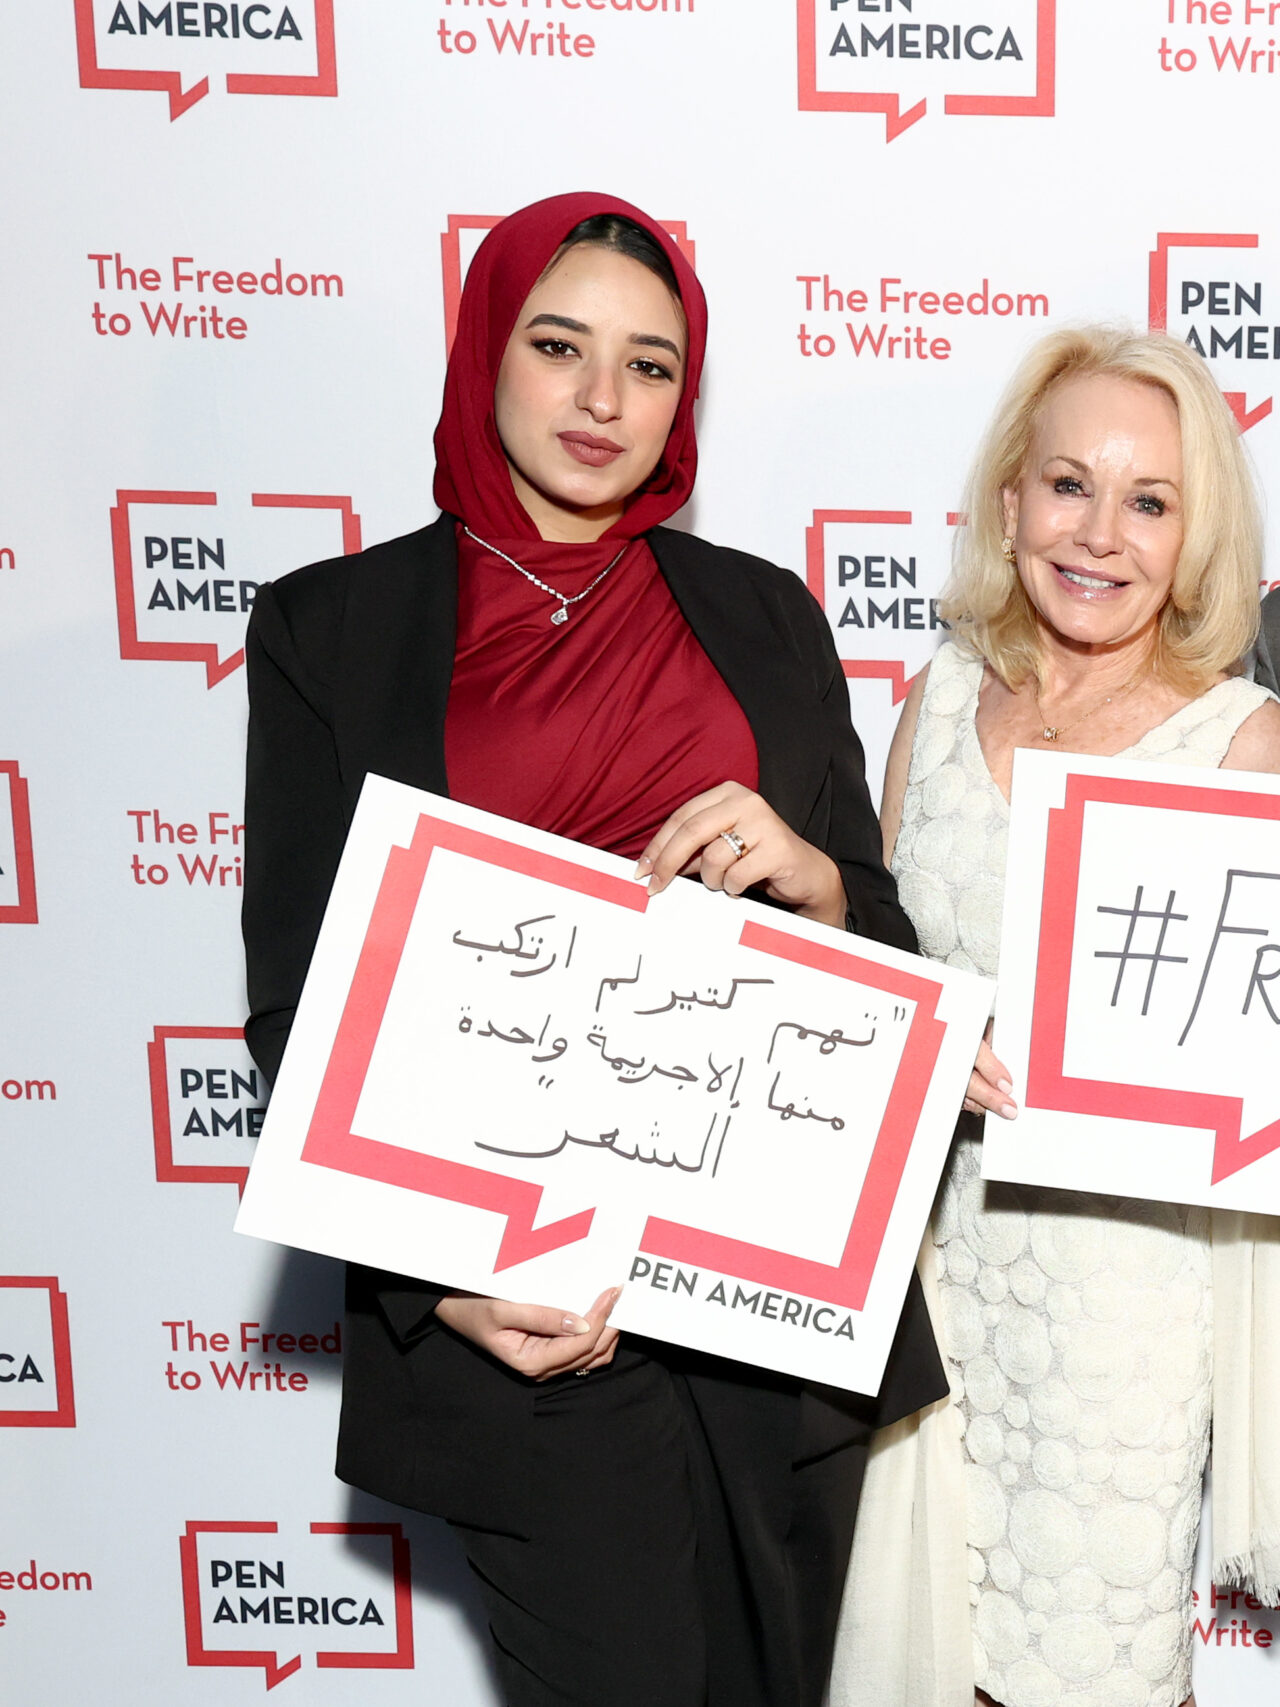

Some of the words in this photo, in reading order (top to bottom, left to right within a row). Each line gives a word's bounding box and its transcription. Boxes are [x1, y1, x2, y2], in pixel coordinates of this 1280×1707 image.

[108, 0, 302, 40] AMERICA
[438, 19, 476, 53] to
[488, 18, 595, 57] Write
[830, 23, 1022, 60] AMERICA
[1159, 38, 1196, 72] to
[88, 253, 160, 291] The
[173, 257, 343, 296] Freedom
[797, 275, 868, 312] The
[881, 278, 1048, 316] Freedom
[1182, 282, 1261, 315] PEN
[92, 303, 130, 335] to
[141, 301, 247, 339] Write
[798, 324, 835, 357] to
[847, 323, 951, 360] Write
[145, 537, 224, 570] PEN
[839, 556, 915, 588] PEN
[148, 578, 259, 613] AMER
[128, 810, 197, 844] The
[132, 855, 168, 884] to
[177, 853, 243, 886] Wri
[180, 1068, 258, 1100] PEN
[628, 1256, 698, 1296] PEN
[705, 1280, 855, 1341] AMERICA
[163, 1320, 229, 1352] The
[240, 1322, 342, 1354] Freed
[166, 1363, 200, 1390] to
[209, 1360, 309, 1392] Write
[0, 1560, 92, 1590] edom
[211, 1560, 284, 1588] PEN
[213, 1596, 384, 1625] AMERICA
